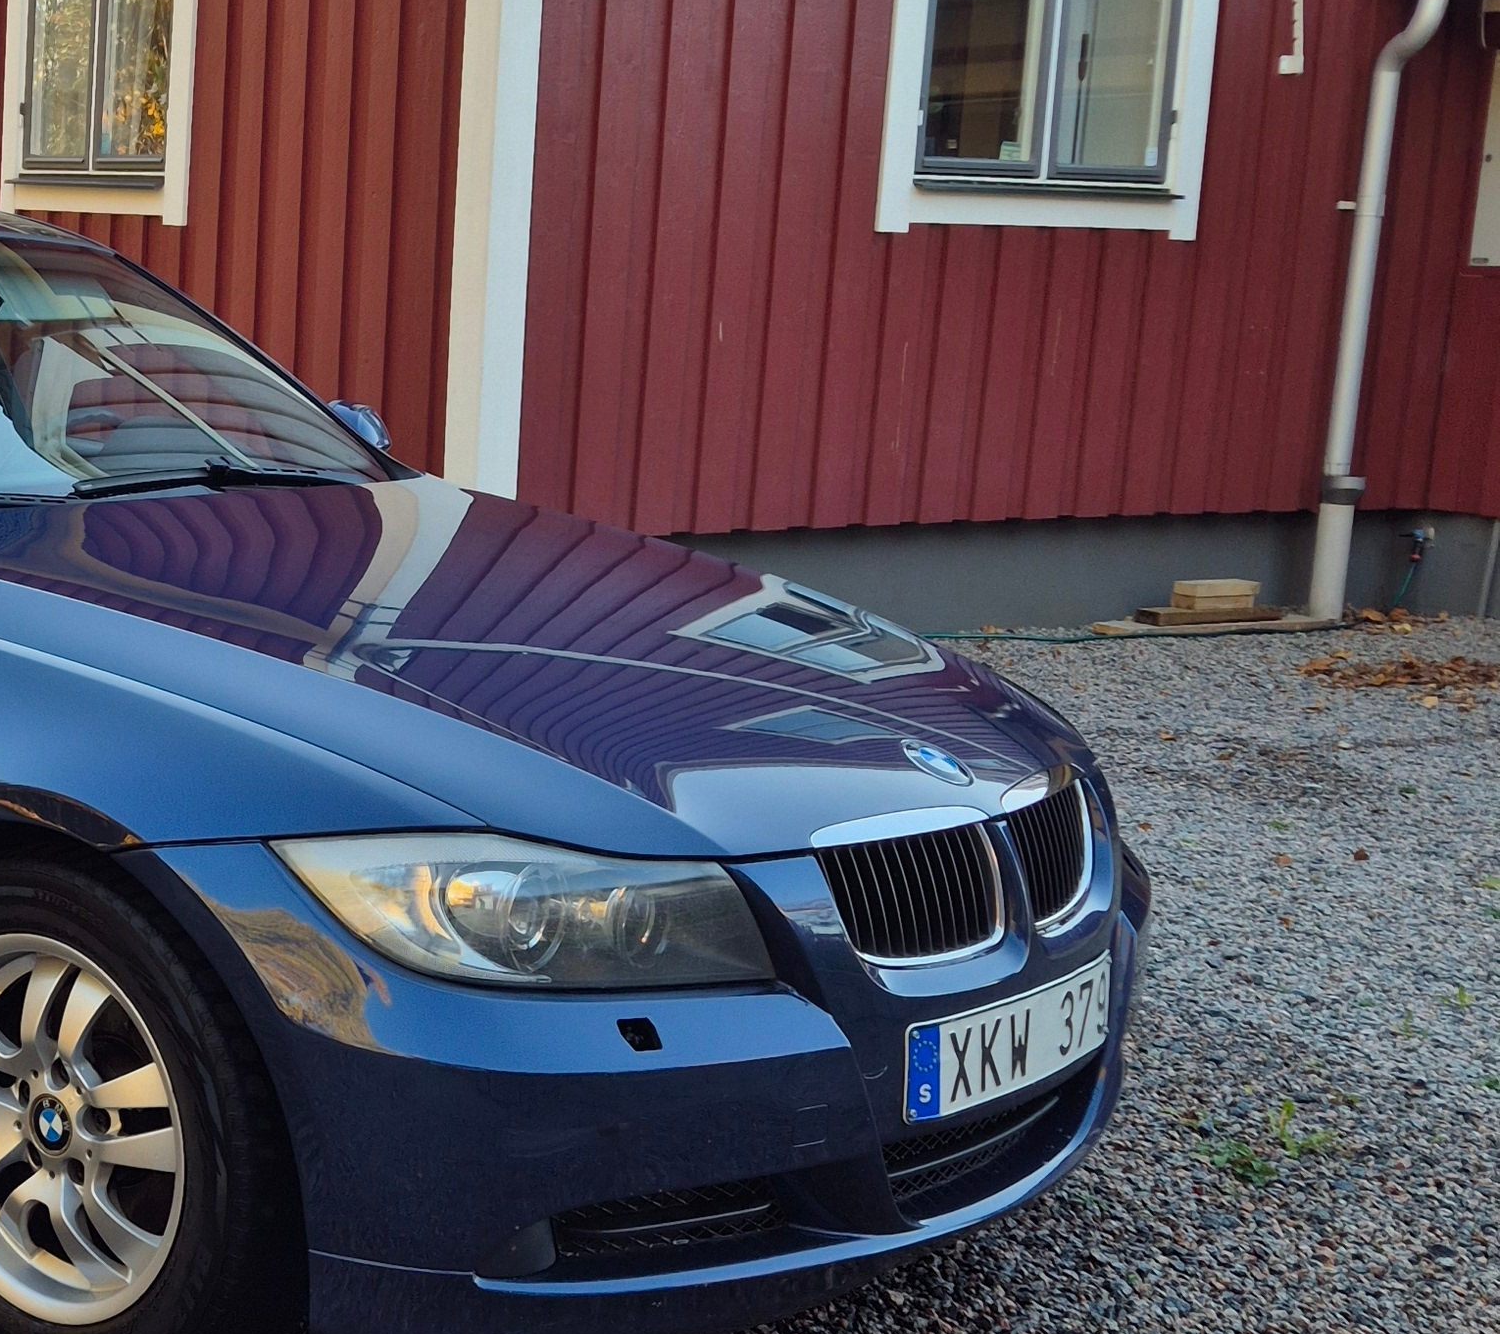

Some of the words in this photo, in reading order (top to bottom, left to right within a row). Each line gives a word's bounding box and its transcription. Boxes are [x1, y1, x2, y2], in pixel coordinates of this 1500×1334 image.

[949, 1008, 1031, 1103] XKW
[1059, 971, 1107, 1057] 379
[918, 1083, 932, 1104] S
[41, 1098, 71, 1132] BMW
